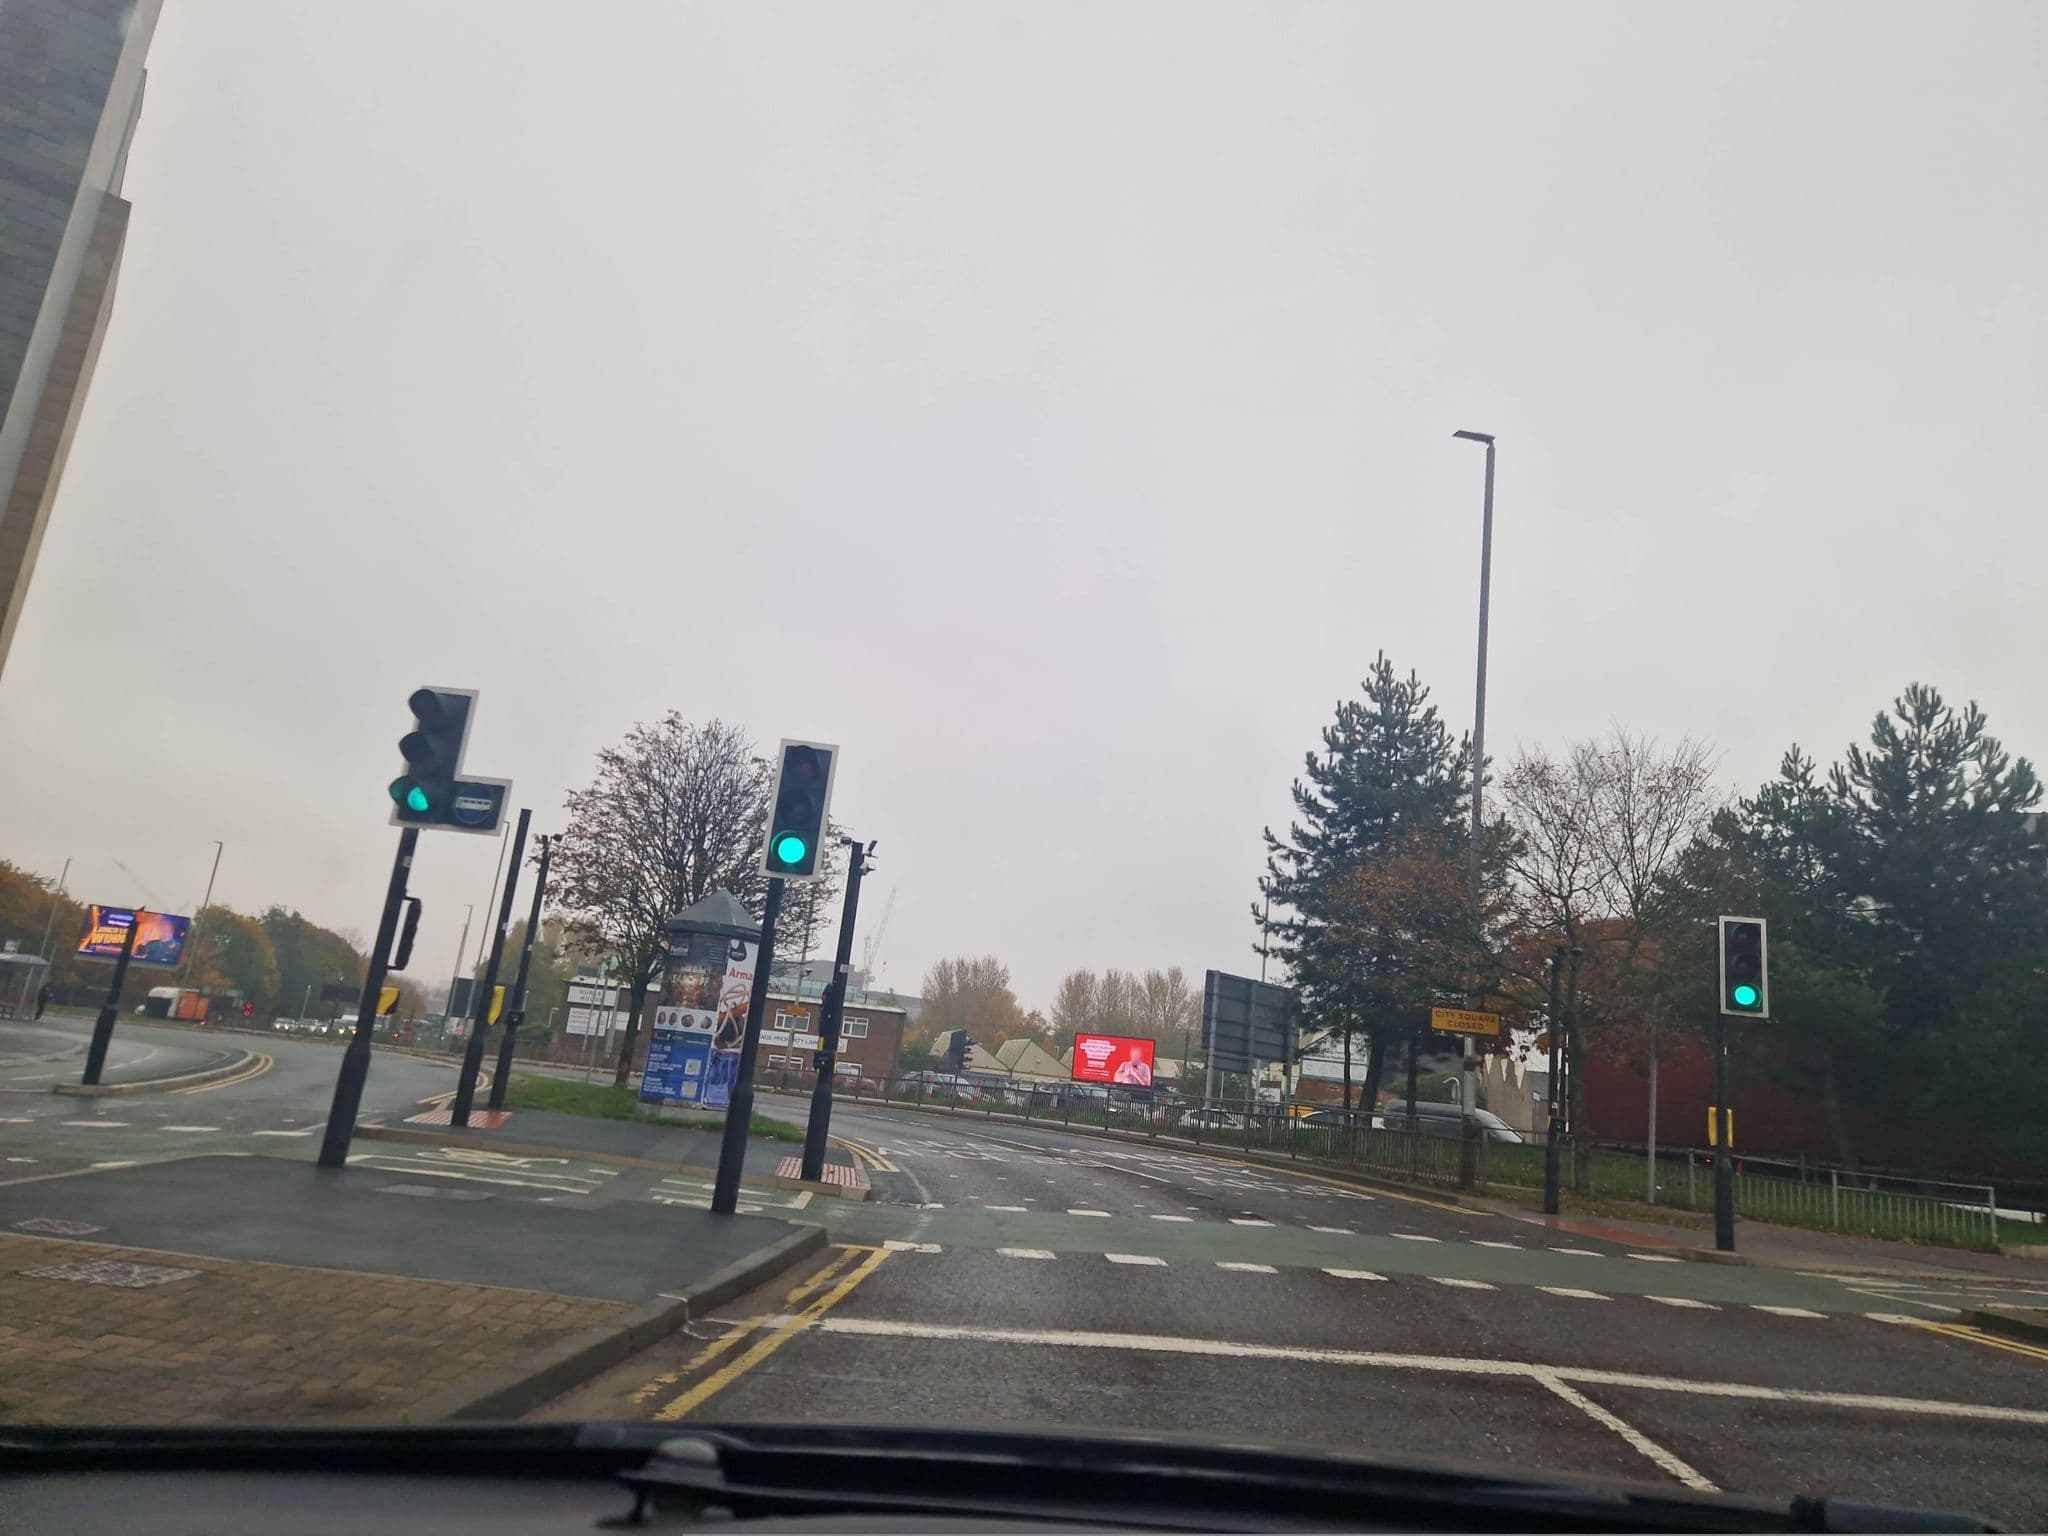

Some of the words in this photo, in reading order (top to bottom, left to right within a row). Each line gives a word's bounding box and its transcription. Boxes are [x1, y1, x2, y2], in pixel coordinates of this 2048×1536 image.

[729, 967, 753, 981] Arma
[1435, 1010, 1454, 1018] CITY
[1458, 1012, 1496, 1024] SQUARE
[1447, 1020, 1485, 1030] CLOSED
[773, 1035, 804, 1044] PROPRTY
